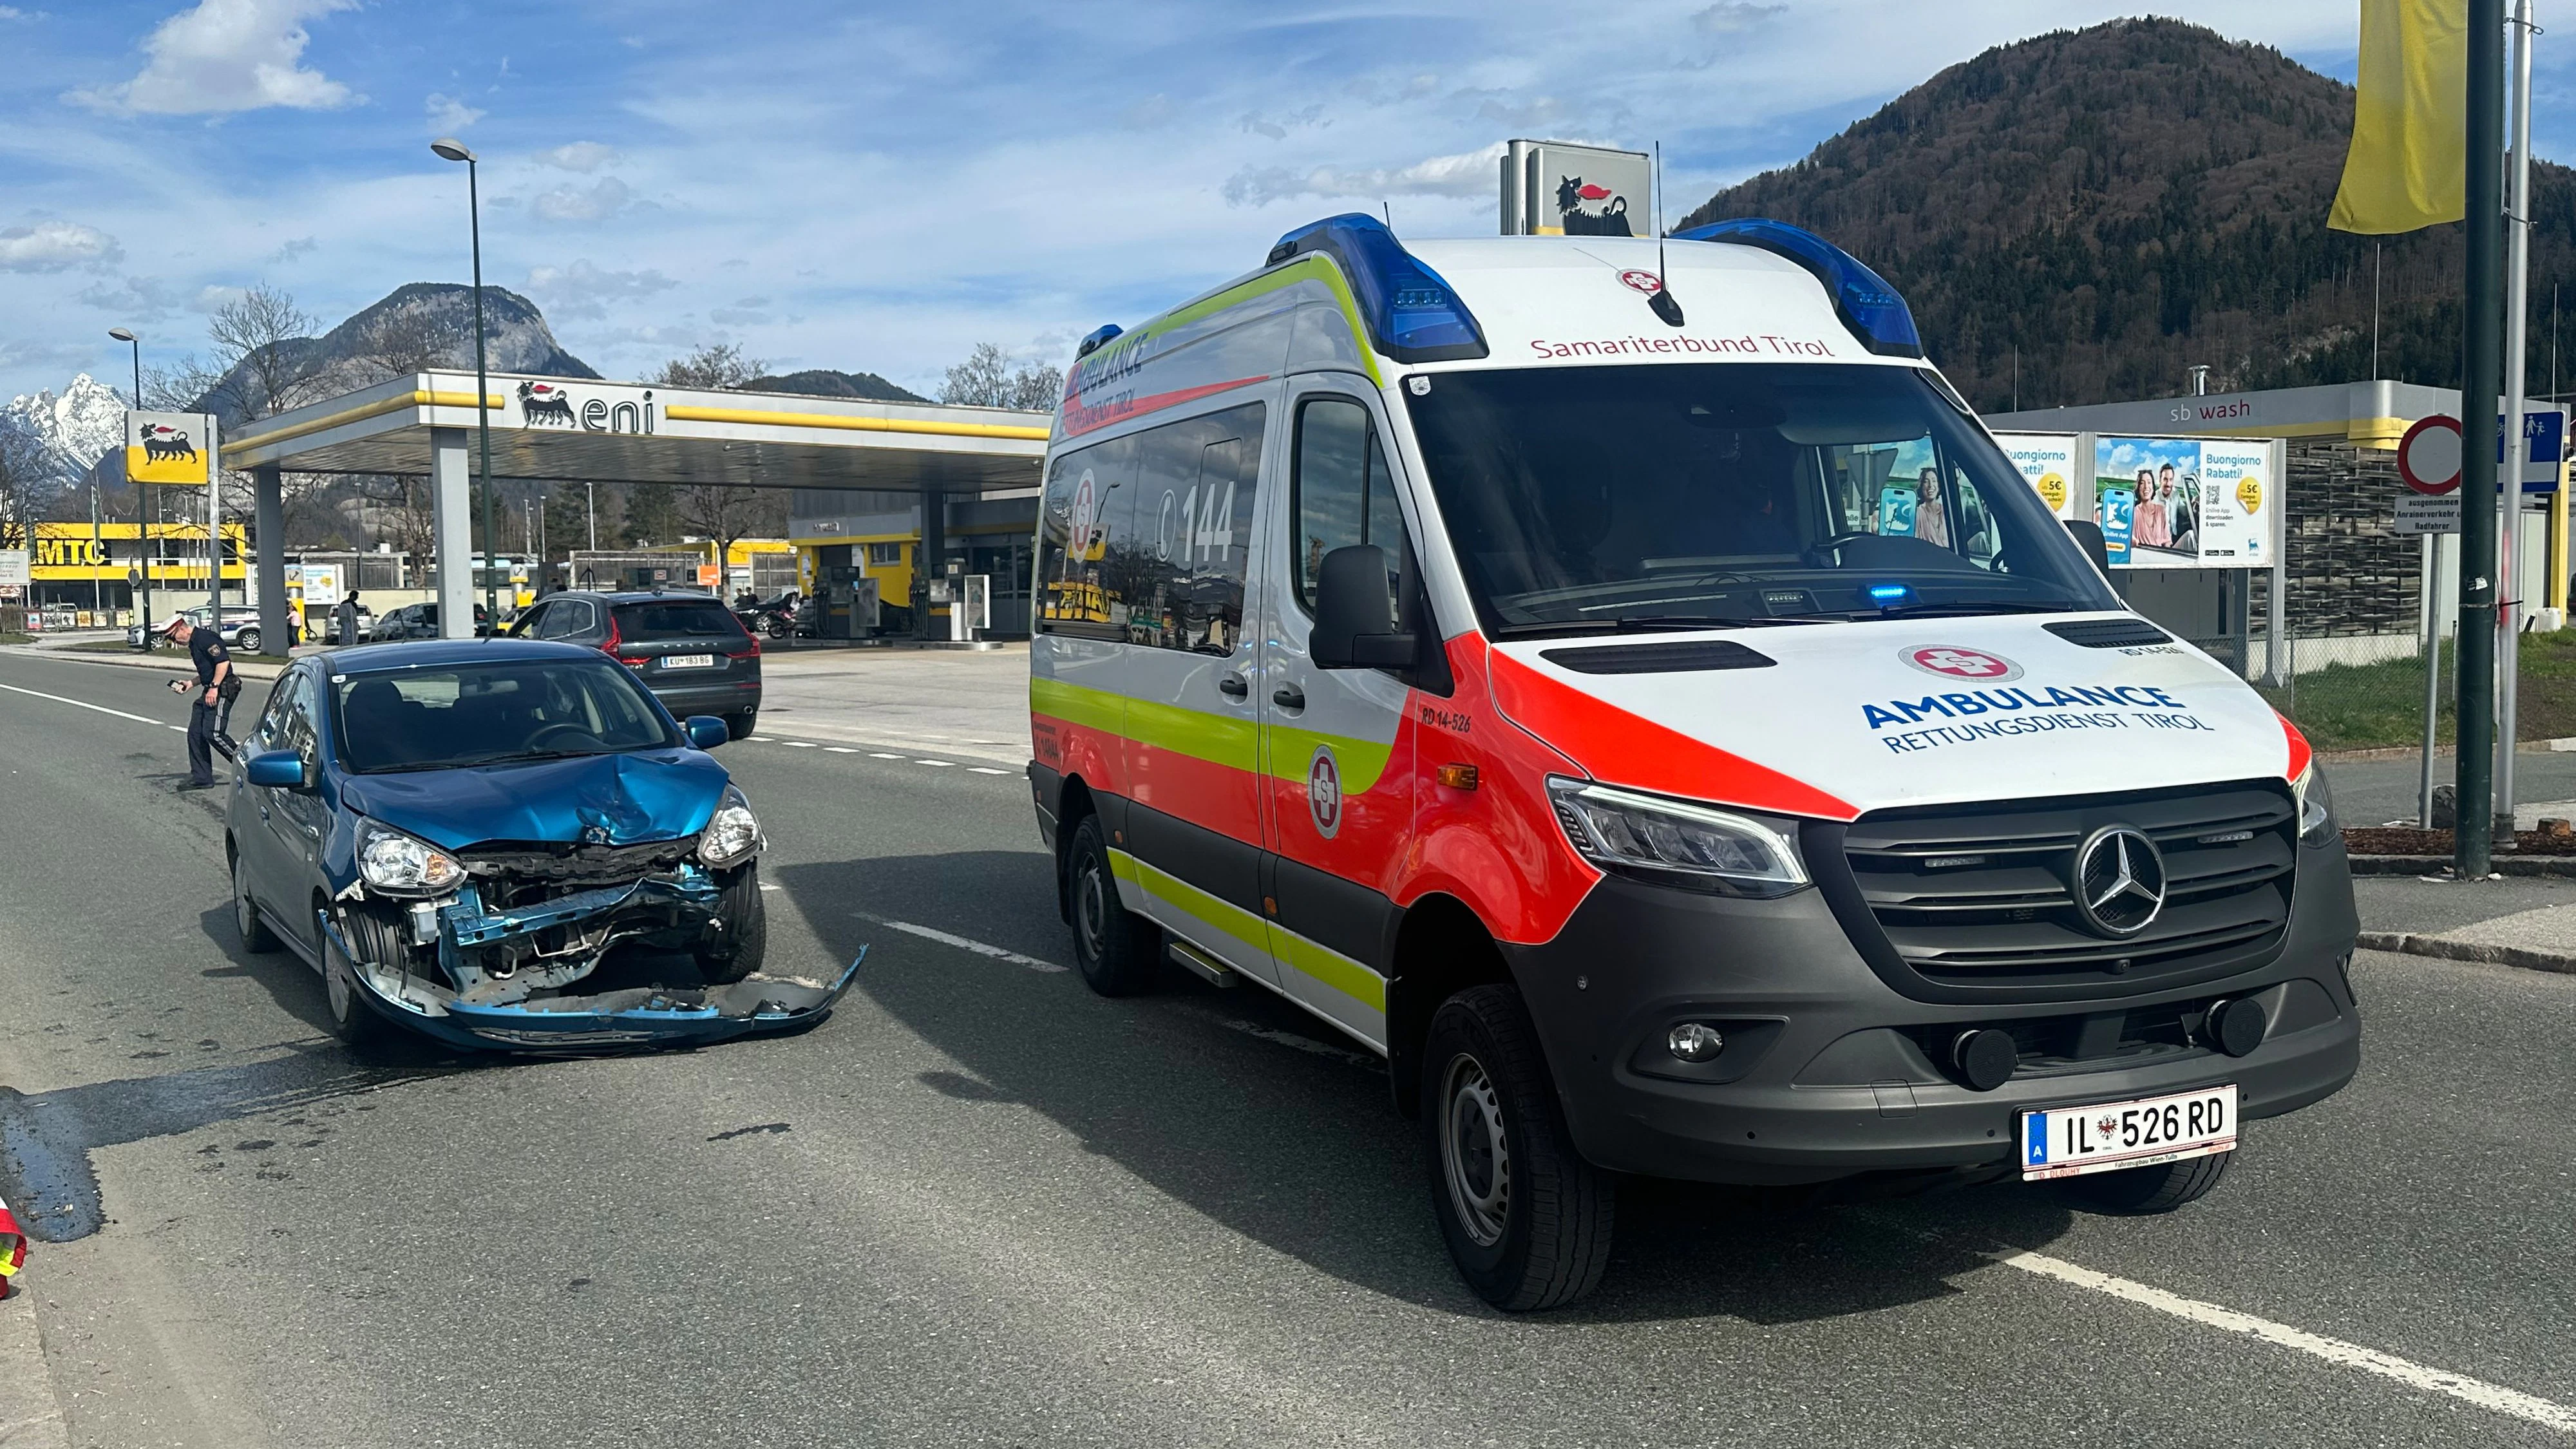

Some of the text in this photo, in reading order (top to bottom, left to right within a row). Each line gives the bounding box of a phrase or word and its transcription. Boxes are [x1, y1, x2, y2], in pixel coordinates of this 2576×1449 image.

[1530, 335, 1835, 359] Samariterbund Tirol
[1065, 331, 1150, 402] AMBULANCE
[581, 390, 654, 434] eni
[1113, 388, 1135, 419] TIROL
[2170, 399, 2250, 422] sb wash
[2005, 449, 2066, 462] uongiorno
[2206, 454, 2261, 467] Buongiorno
[2020, 464, 2044, 475] atti!
[2206, 468, 2242, 478] Rabatti!
[2049, 481, 2062, 490] 5€
[2247, 484, 2258, 493] 5€
[2409, 499, 2459, 507] ausgenommen
[1182, 480, 1235, 562] 144
[2397, 510, 2455, 518] Anrainerverkehr
[31, 540, 105, 565] MTC
[700, 655, 709, 663] BG
[1861, 686, 2187, 730] AMBULANCE
[1421, 707, 1472, 733] RD 14-526
[1882, 713, 2216, 754] RETTUNGSDIENST TIROL
[2032, 1097, 2223, 1157] A IL 526 RD
[2115, 1156, 2149, 1168] Fahrzeugbau
[2050, 1167, 2081, 1178] DLOUHY
